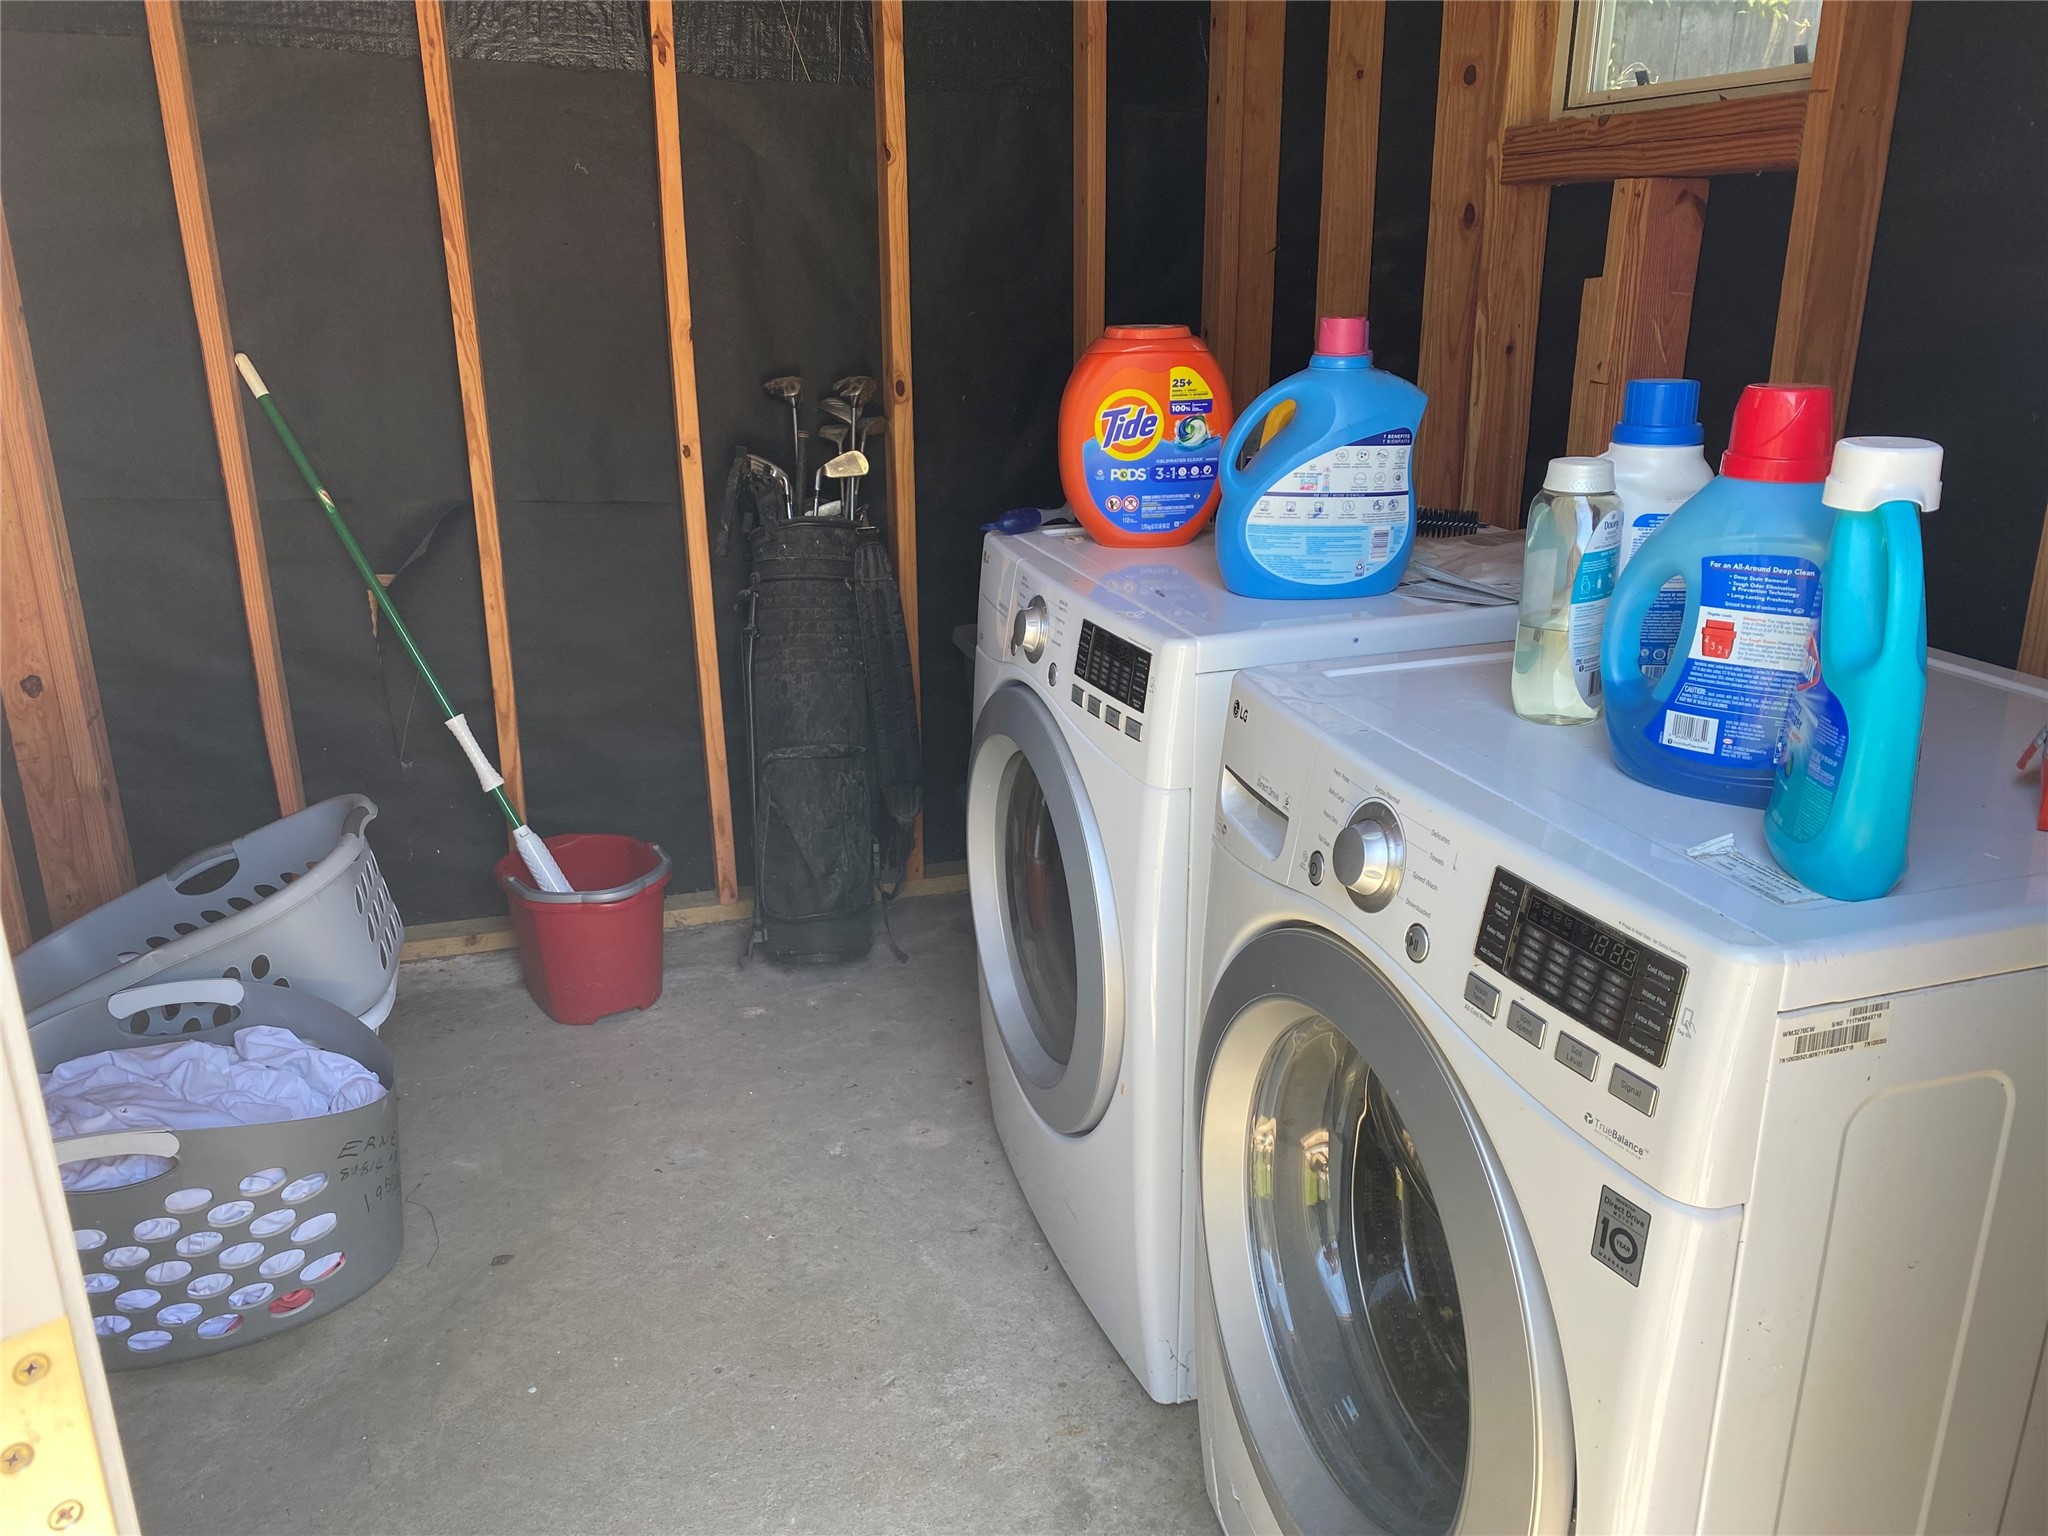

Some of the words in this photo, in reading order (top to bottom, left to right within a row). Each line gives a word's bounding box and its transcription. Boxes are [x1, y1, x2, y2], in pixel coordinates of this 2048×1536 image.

[1172, 378, 1192, 388] 25+
[1172, 405, 1191, 413] 100%
[1101, 406, 1159, 450] Tide
[1110, 468, 1147, 481] PODS
[1604, 520, 1620, 530] Downy
[1733, 563, 1771, 573] All-Around
[1773, 567, 1793, 576] Deep
[1794, 569, 1815, 577] Clean
[1731, 593, 1765, 602] Long-Lasting
[1766, 596, 1794, 604] Freshness
[1769, 590, 1801, 599] Technology
[1711, 642, 1716, 651] 3
[1717, 646, 1723, 654] 2
[1685, 685, 1707, 695] CAUTION:
[1240, 706, 1249, 723] LG
[1257, 778, 1269, 791] Direct
[1268, 788, 1279, 802] Drive
[1431, 829, 1450, 846] Delicates
[1430, 852, 1445, 867] Towels
[1412, 871, 1426, 884] Speed
[1426, 880, 1439, 892] Wash
[1405, 898, 1432, 919] Downloaded
[1647, 964, 1658, 976] Cold
[1475, 984, 1489, 998] Wash
[1642, 988, 1657, 1001] Water
[1656, 996, 1667, 1008] Plus
[1470, 1007, 1480, 1018] Cold
[1479, 1013, 1493, 1027] Rinses
[1520, 1014, 1532, 1026] Spin
[1635, 1012, 1647, 1024] Extra
[1648, 1020, 1661, 1032] Rinse
[1516, 1021, 1533, 1037] Speed
[1782, 1026, 1816, 1038] WM3270CW
[1571, 1046, 1583, 1057] Soil
[1629, 1037, 1655, 1057] Rinse+Spin
[1566, 1053, 1583, 1068] Level
[1620, 1080, 1642, 1098] Signal
[1604, 1196, 1625, 1216] Direct
[1626, 1210, 1645, 1228] Drive
[1613, 1210, 1634, 1227] MOTOR
[1600, 1216, 1639, 1265] 10
[1616, 1239, 1631, 1253] YEAR
[1598, 1250, 1633, 1278] WARRANTY
